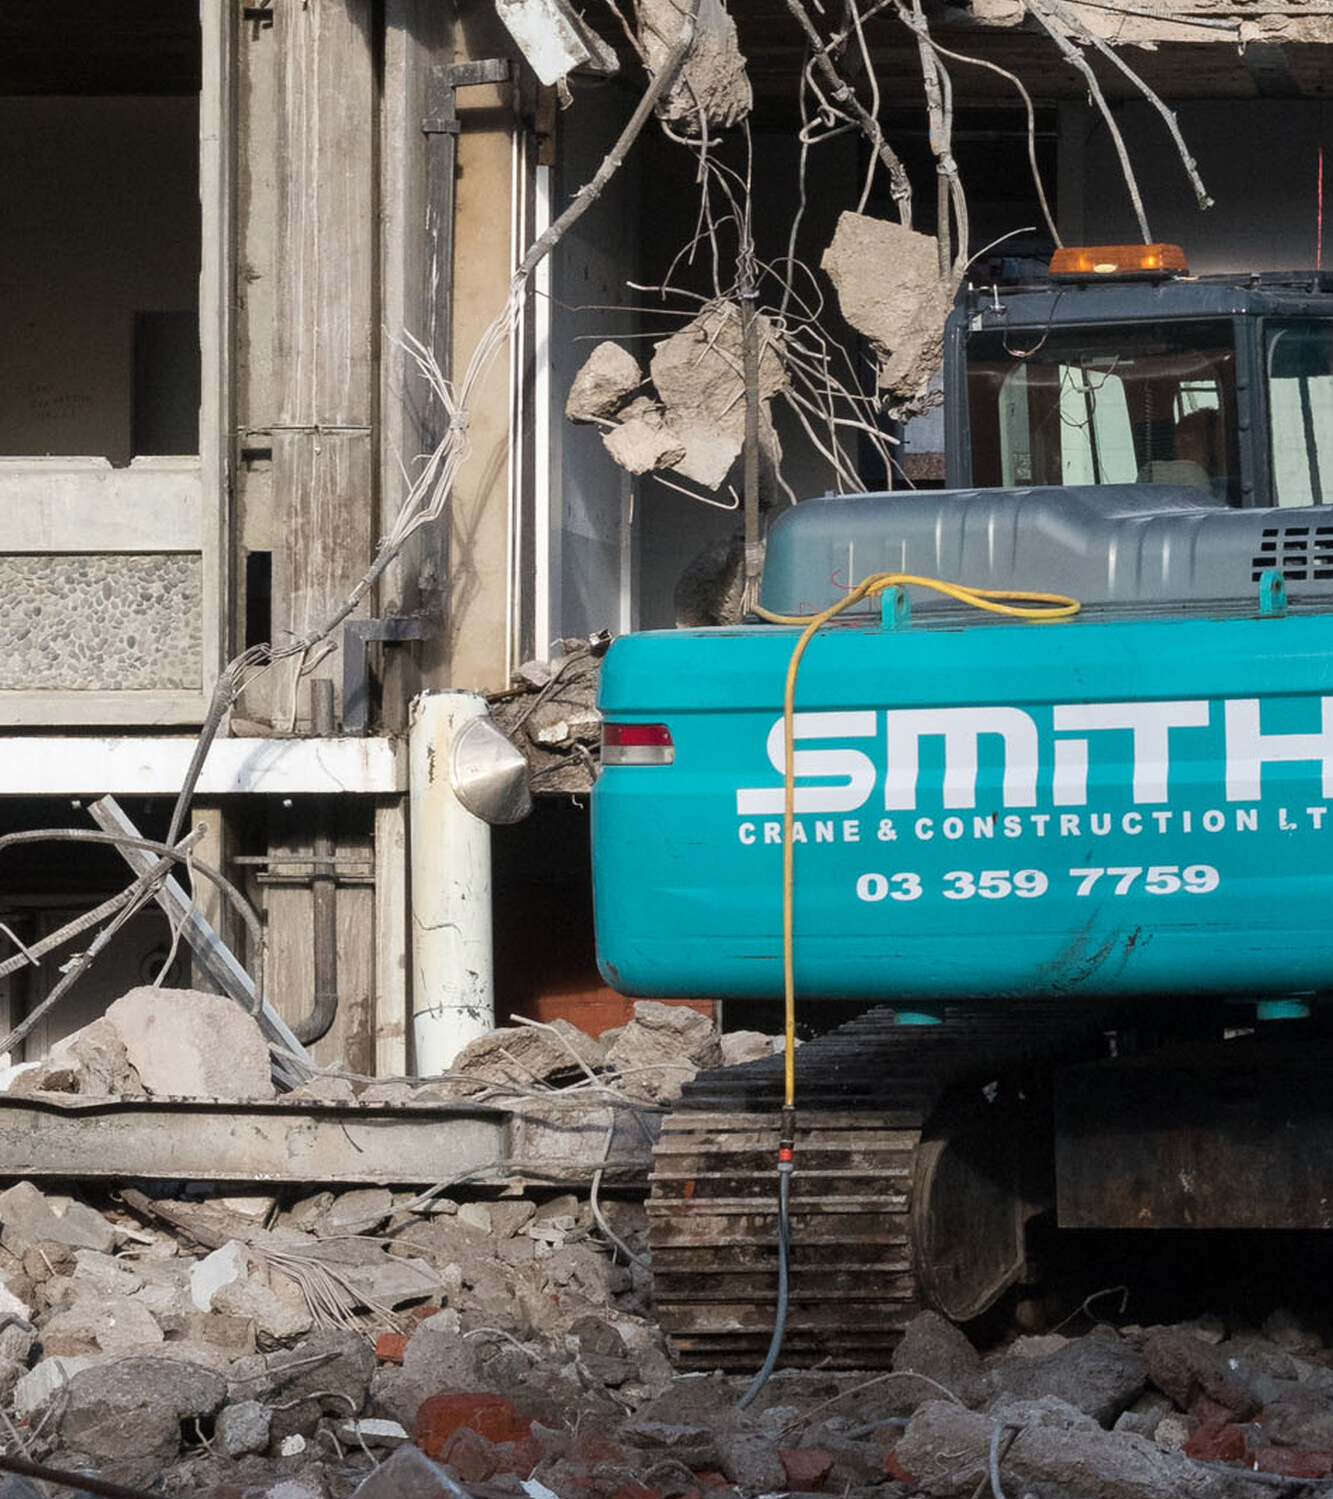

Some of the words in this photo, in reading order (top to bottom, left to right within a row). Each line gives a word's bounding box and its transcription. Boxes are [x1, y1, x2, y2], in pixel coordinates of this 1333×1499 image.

[738, 819, 860, 845] CRANE
[877, 818, 898, 841] &
[914, 808, 1258, 840] CONSTRUCTION
[856, 872, 923, 902] 03
[943, 869, 1049, 900] 359
[1069, 864, 1220, 896] 7759
